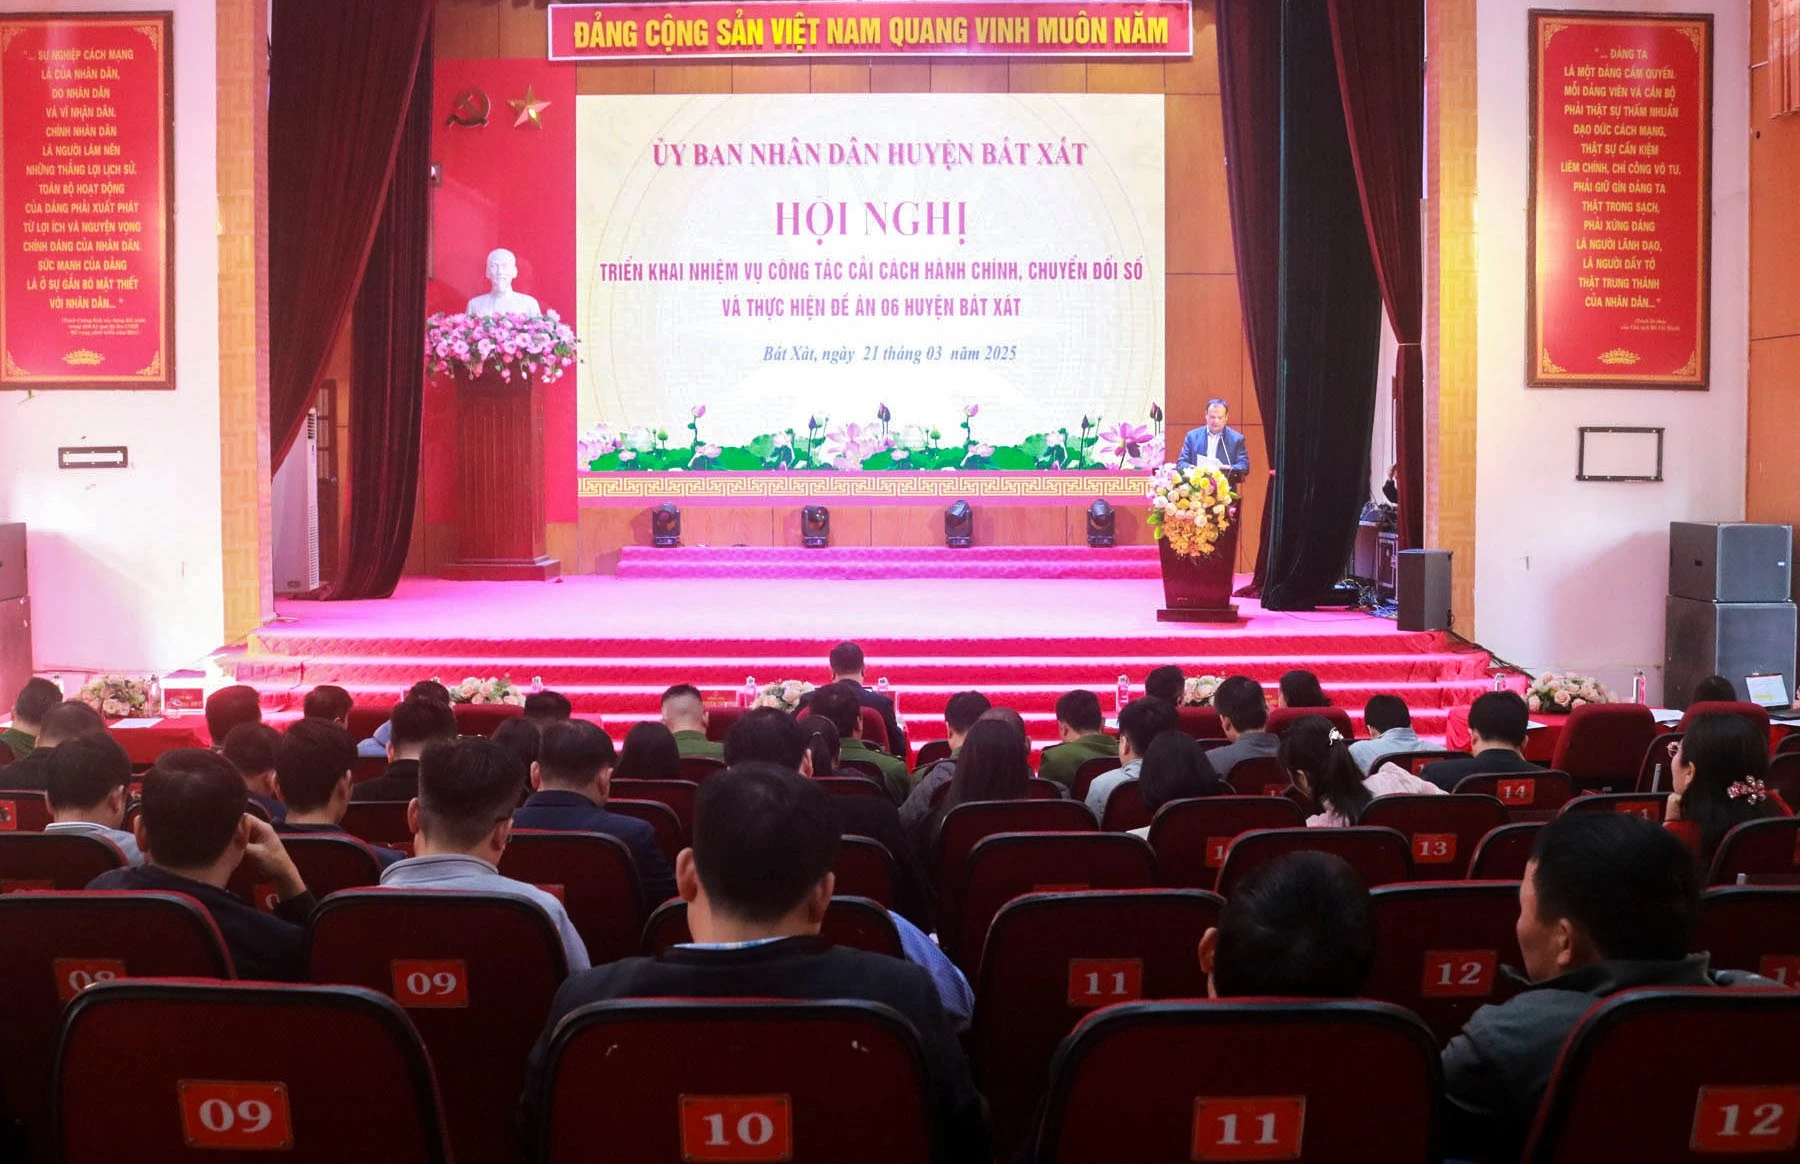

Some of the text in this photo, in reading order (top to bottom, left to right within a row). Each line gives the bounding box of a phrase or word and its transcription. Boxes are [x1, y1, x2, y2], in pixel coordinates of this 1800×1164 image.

[574, 11, 1168, 52] ĐẢNG CỘNG SẢN VIỆT NAM QUANG VINH MUÔN NĂM
[653, 136, 1087, 170] ỦY BAN NHÂN DÂN HUYỆN BÁT XÁT
[776, 196, 966, 246] HỘI NGHỊ
[600, 256, 643, 281] TRIỂN
[649, 263, 683, 281] KHAI
[690, 259, 738, 284] NHIỆM
[744, 263, 762, 284] VỤ
[769, 259, 808, 280] CÔNG
[815, 259, 842, 280] TÁC
[849, 257, 873, 280] CẢI
[880, 262, 919, 280] CÁCH
[925, 262, 965, 279] HÀNH
[1029, 255, 1087, 280] CHUYỂN
[1093, 255, 1118, 280] ĐỔI
[1124, 256, 1142, 280] SỐ
[722, 293, 1021, 320] VÀ THỰC HIỆN ĐỀ ÁN 06 HUYỆN BÁT XÁT
[763, 346, 1016, 364] Bát Xát, ngày 21 tháng 03 năm 2025
[1503, 784, 1527, 799] 14
[1419, 840, 1449, 856] 13
[406, 971, 457, 996] 09
[1083, 971, 1129, 996] 11
[1436, 961, 1482, 986] 12
[199, 1098, 273, 1133] 09
[702, 1112, 774, 1146] 10
[1215, 1112, 1279, 1145] 11
[1715, 1102, 1785, 1136] 12
